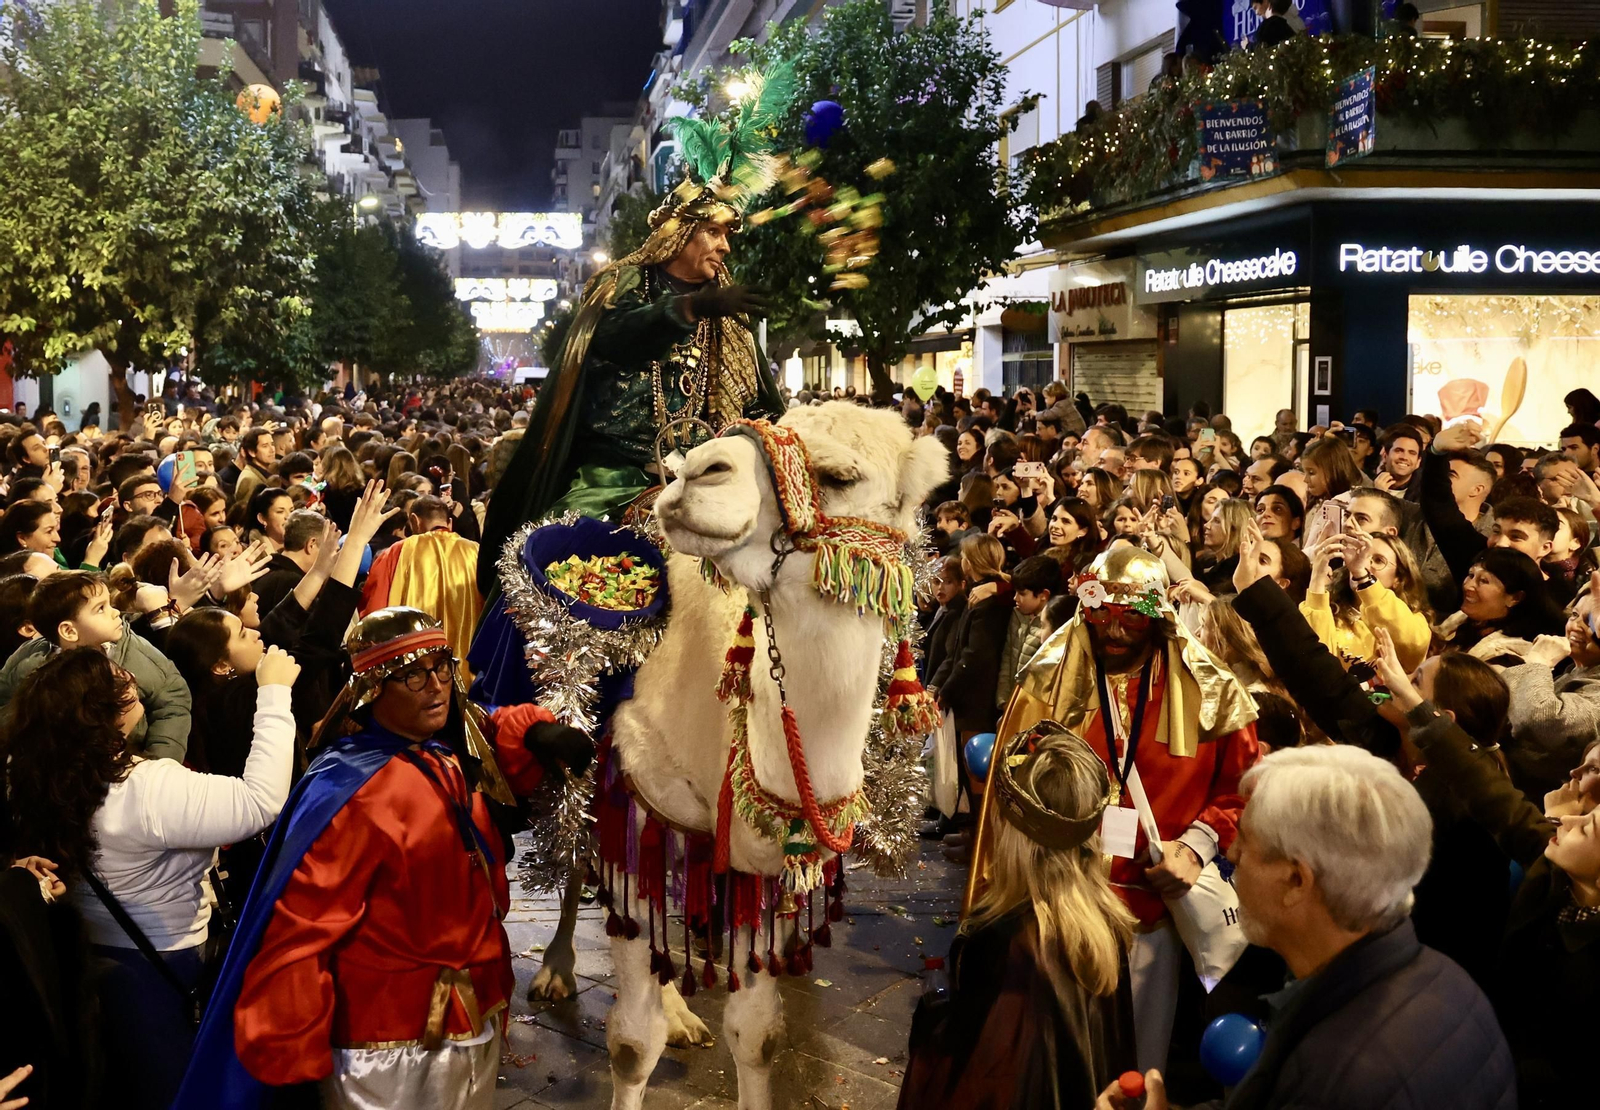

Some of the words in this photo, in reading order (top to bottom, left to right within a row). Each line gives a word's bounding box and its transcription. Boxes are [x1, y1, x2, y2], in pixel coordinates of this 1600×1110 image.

[1206, 115, 1264, 129] BIENVENIDOS
[1213, 131, 1224, 140] AL
[1225, 128, 1258, 140] BARRIO
[1206, 143, 1218, 153] DE
[1219, 143, 1230, 152] LA
[1231, 138, 1267, 152] ILUSIÓN
[1205, 247, 1297, 286] Cheesecake
[1051, 290, 1067, 313] LA
